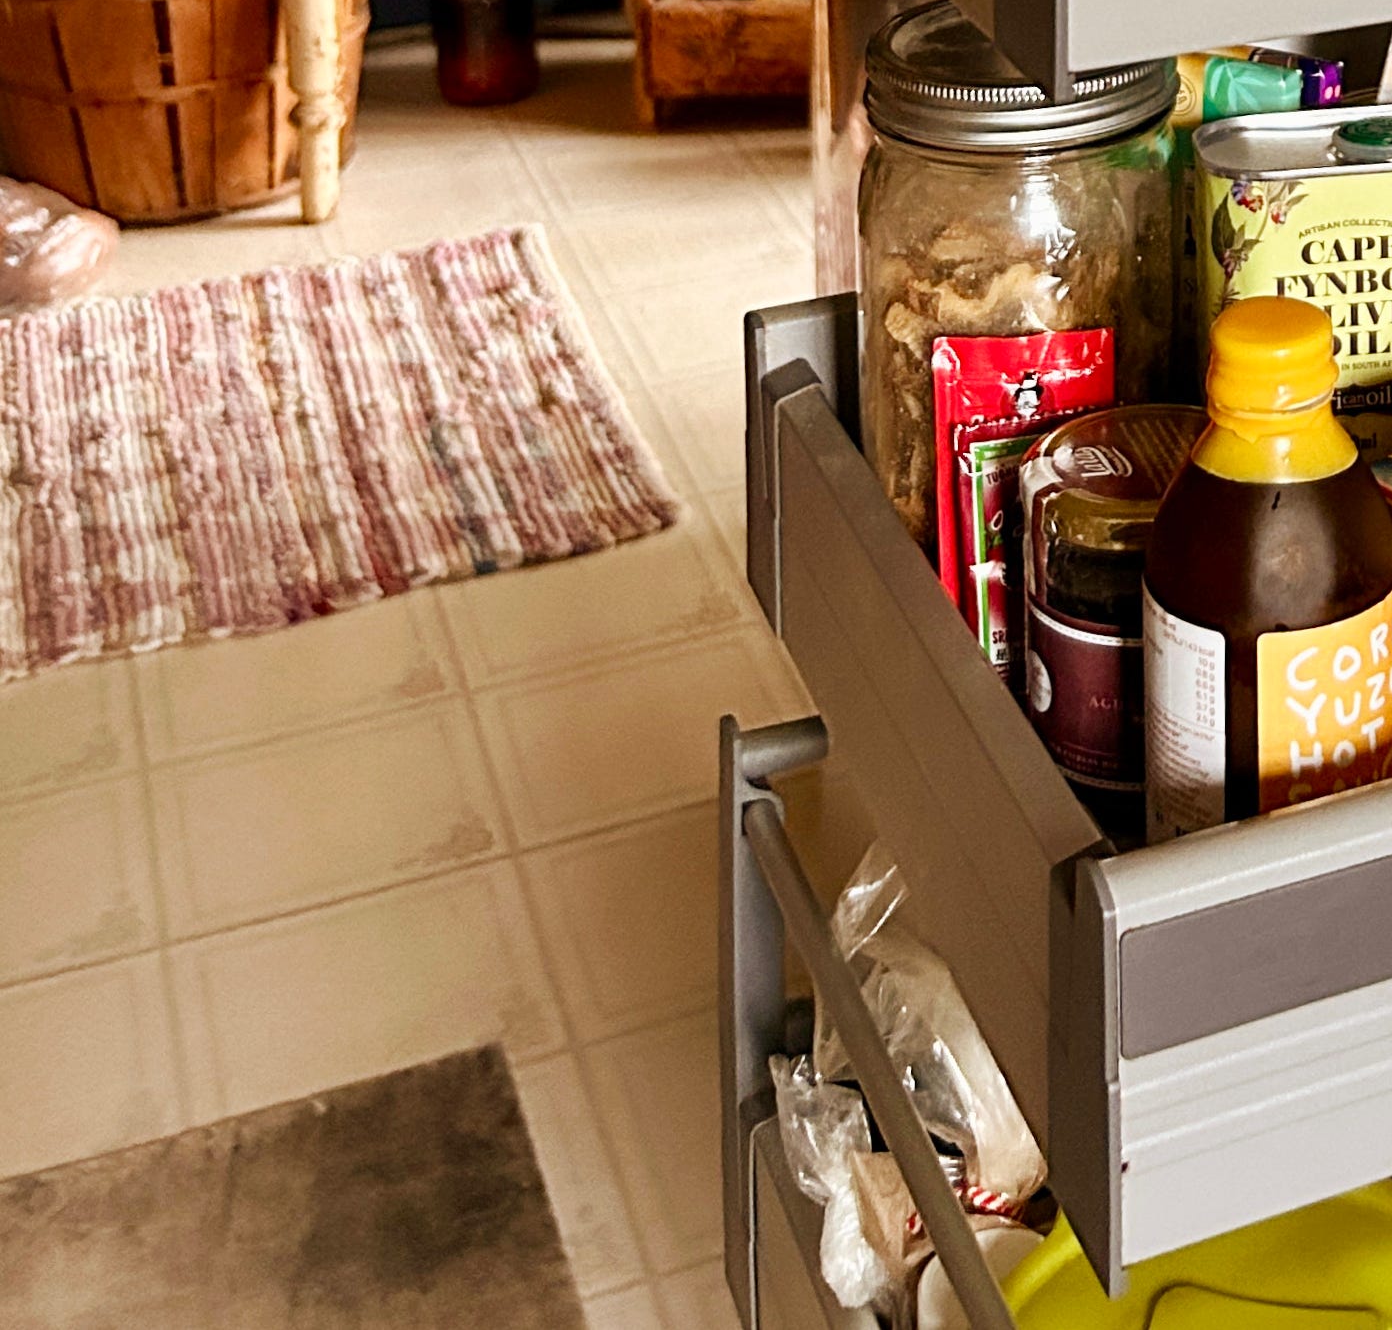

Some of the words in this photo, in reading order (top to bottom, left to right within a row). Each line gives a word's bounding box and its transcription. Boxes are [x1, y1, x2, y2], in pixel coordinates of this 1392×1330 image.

[1299, 220, 1341, 239] ARTISAN
[1352, 362, 1381, 371] SOUTH
[1289, 717, 1385, 778] HOT
